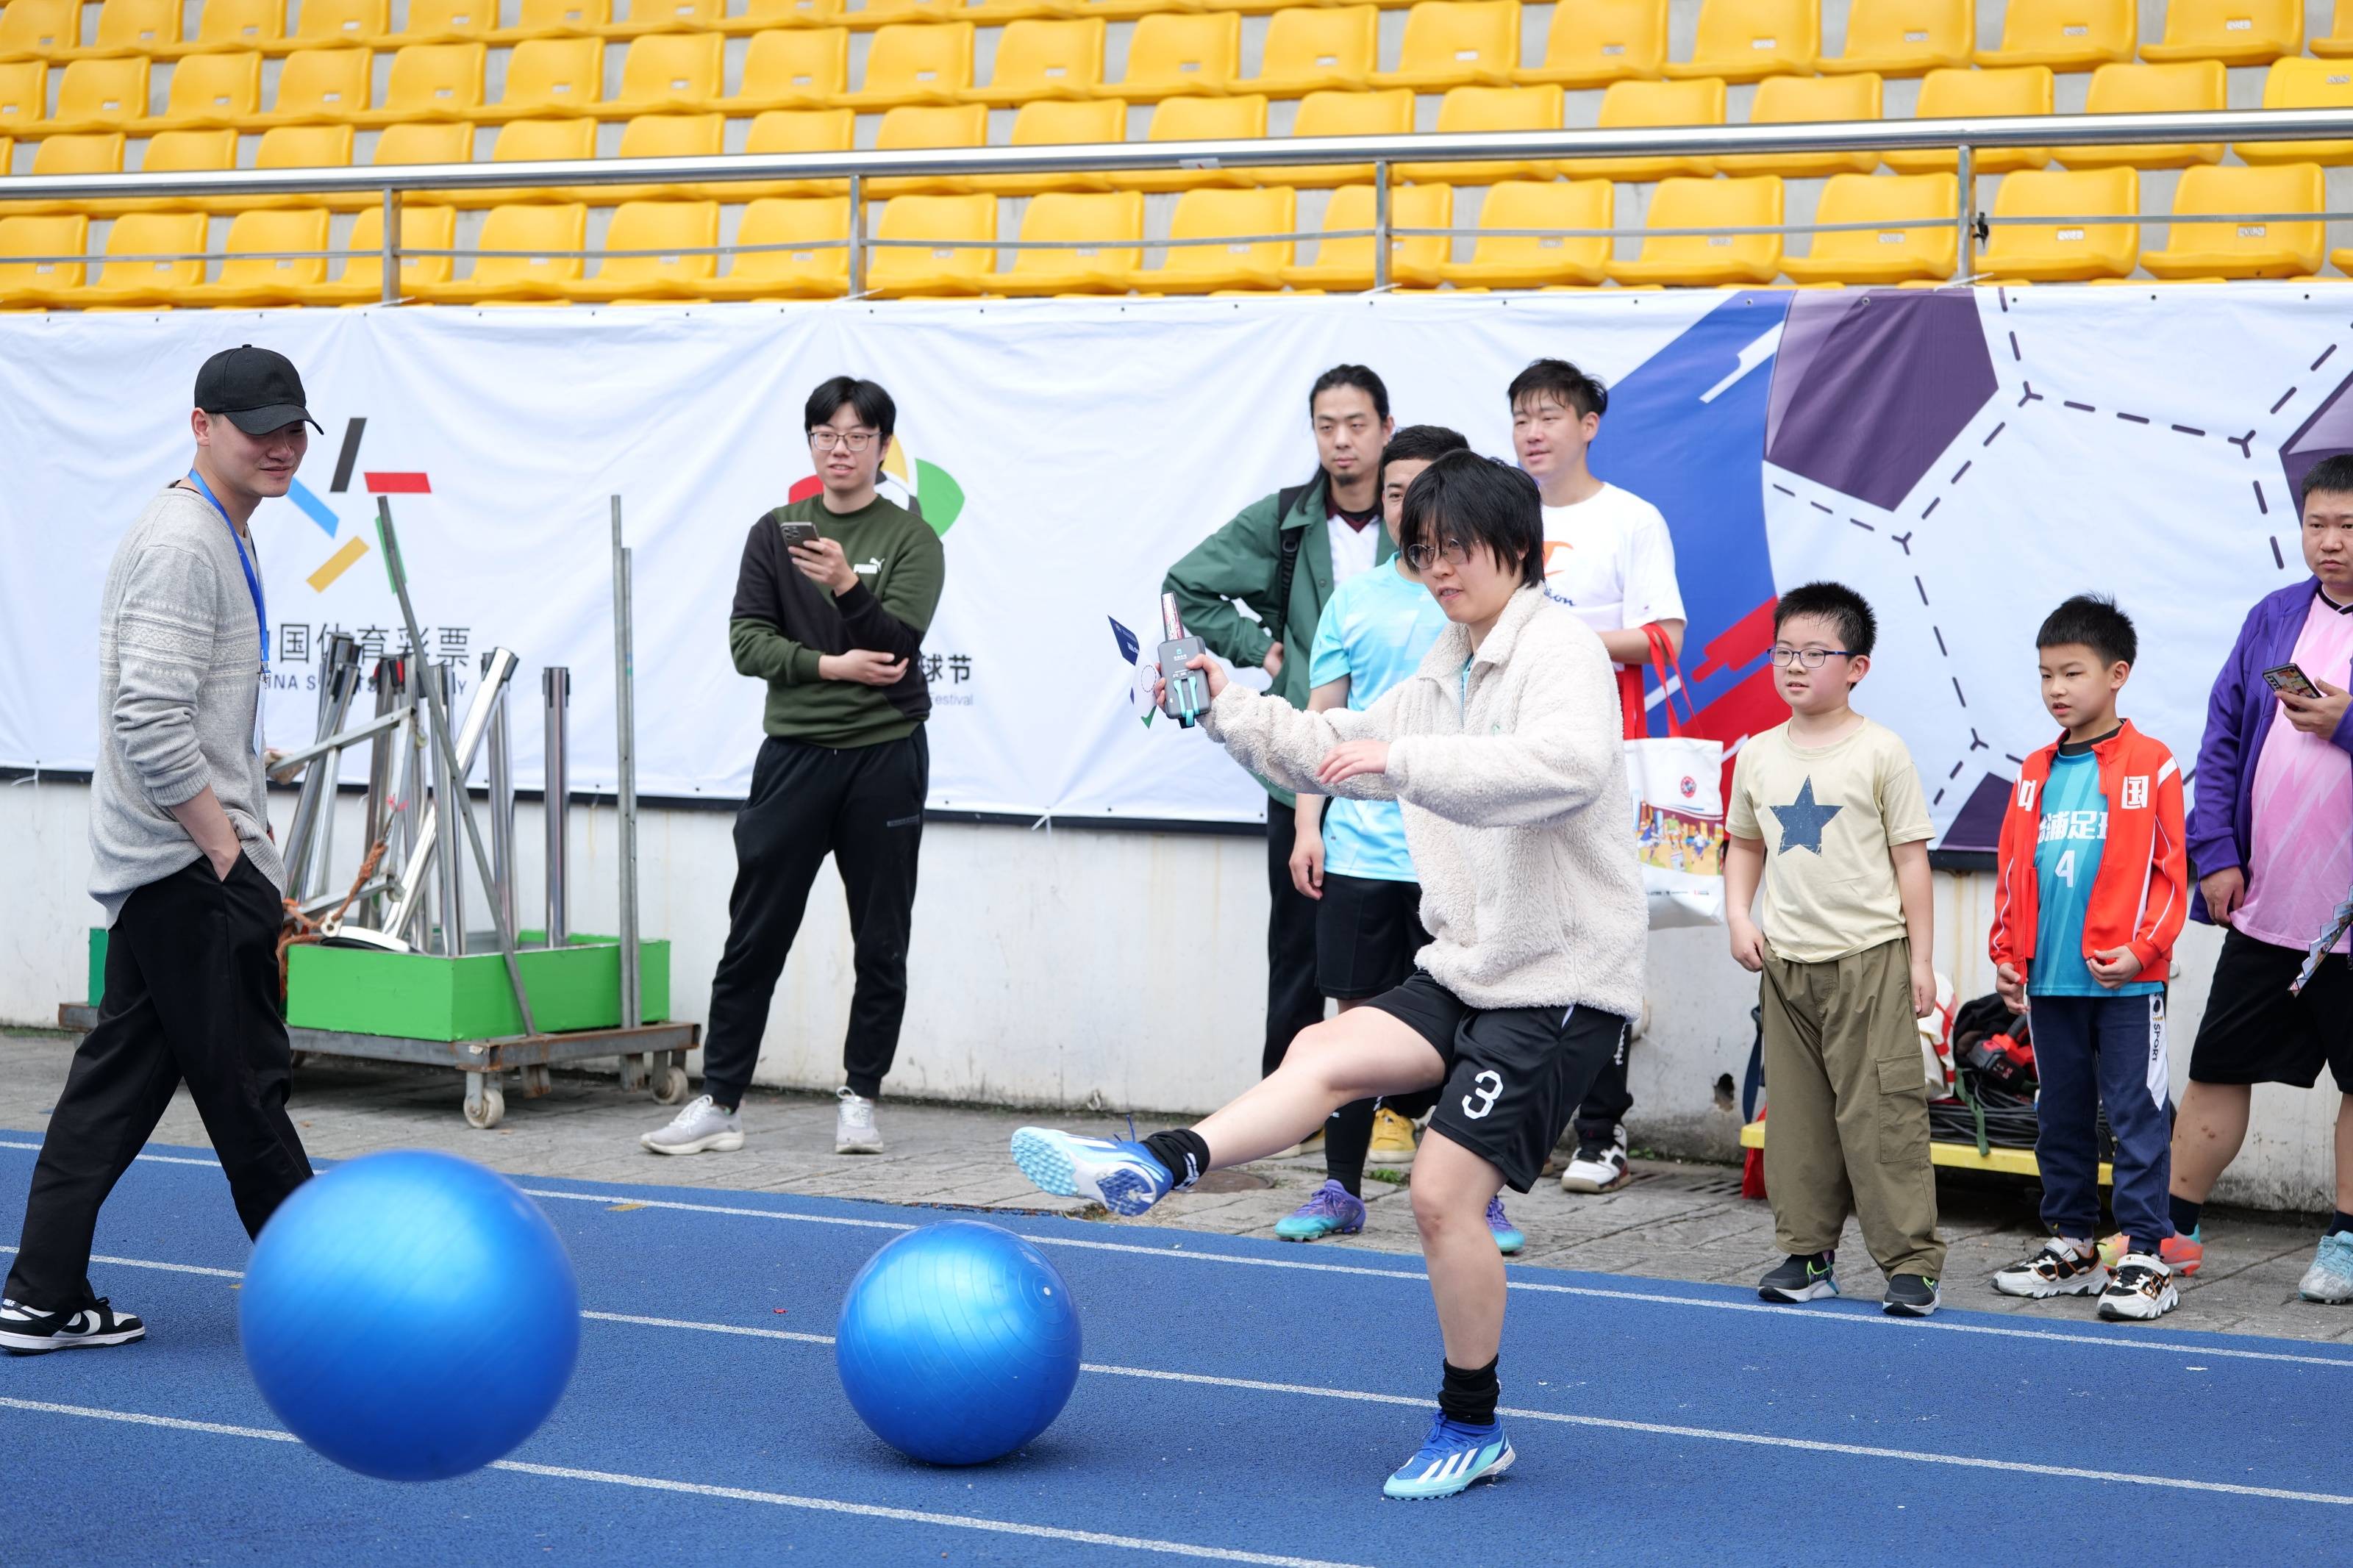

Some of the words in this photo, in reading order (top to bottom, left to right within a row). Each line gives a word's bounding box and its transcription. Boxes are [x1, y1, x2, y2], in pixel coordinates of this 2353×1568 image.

[267, 623, 471, 666] 国体育彩票
[268, 675, 299, 690] INA
[2054, 850, 2076, 888] 4
[2152, 1023, 2160, 1062] SPORT
[1462, 1070, 1503, 1119] 3
